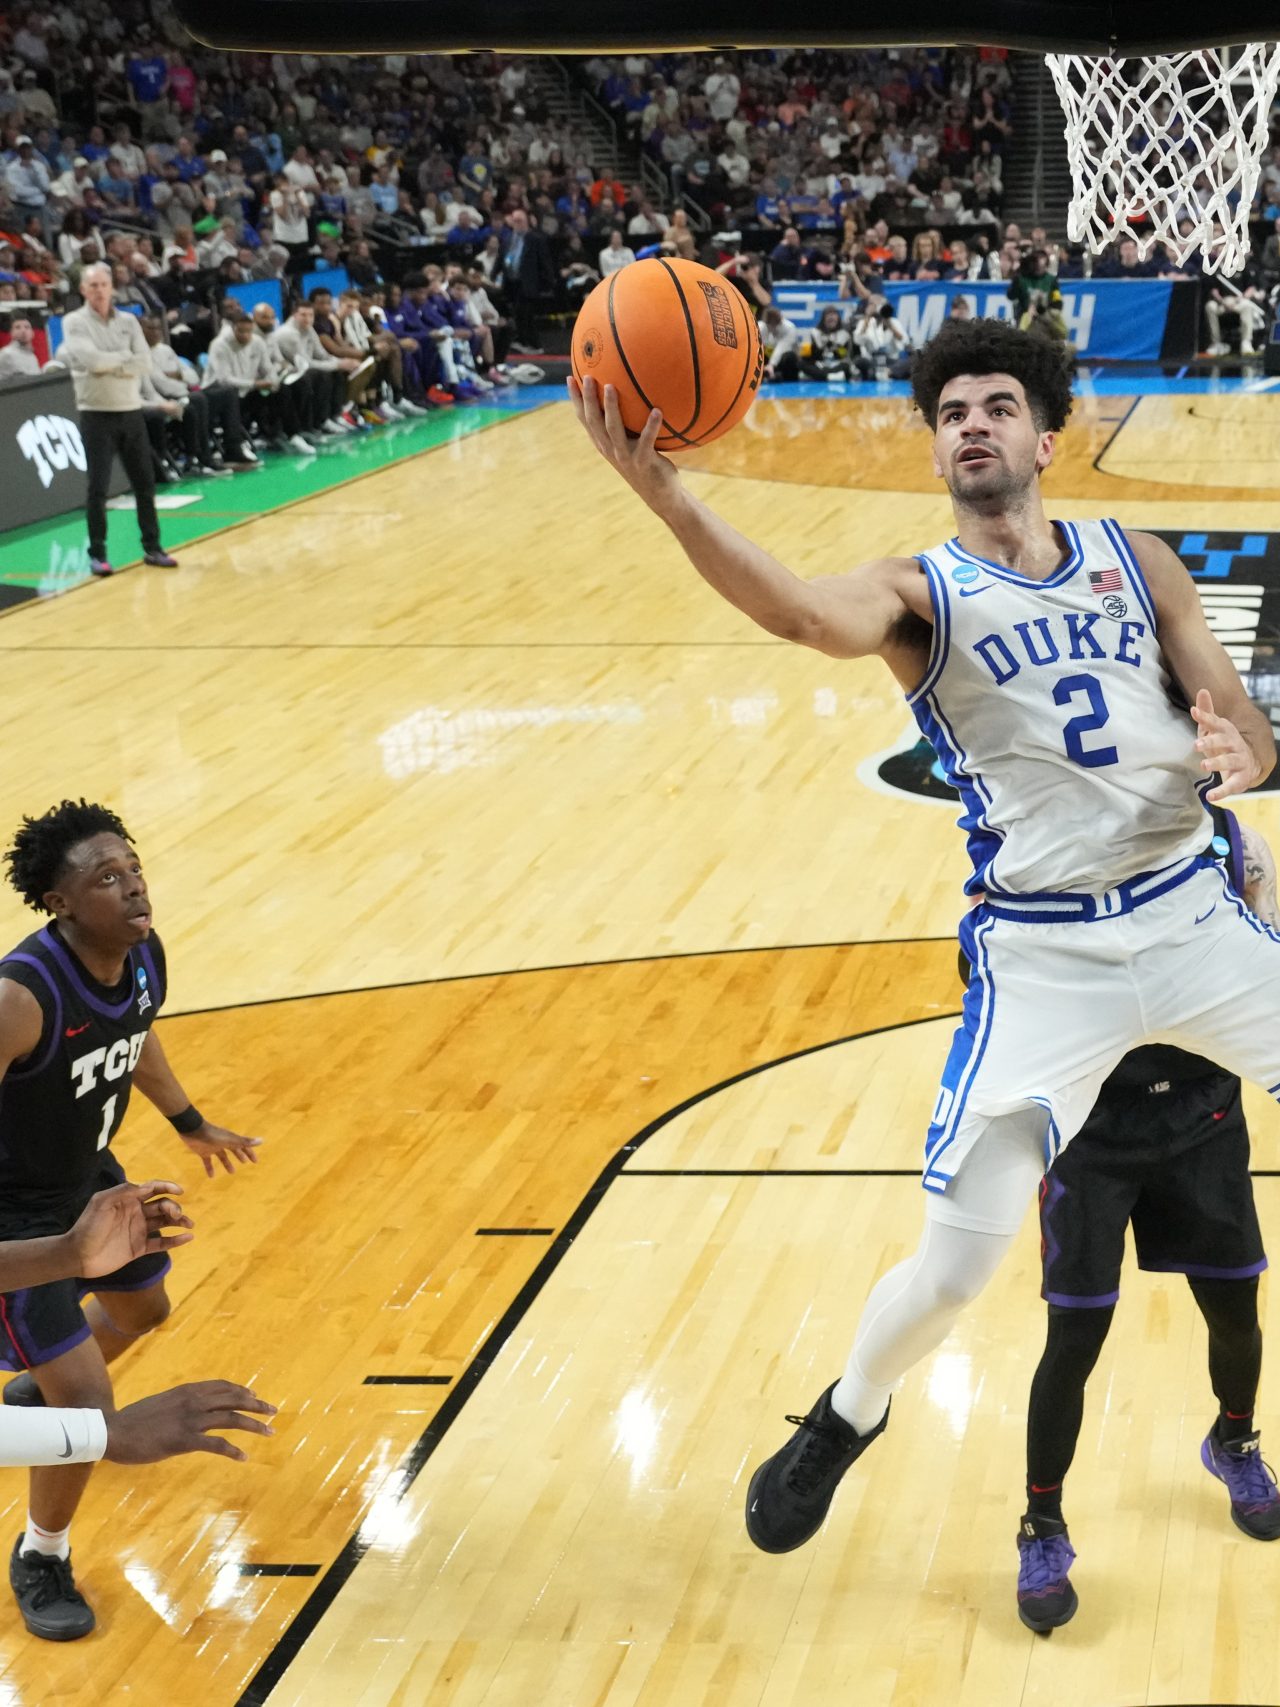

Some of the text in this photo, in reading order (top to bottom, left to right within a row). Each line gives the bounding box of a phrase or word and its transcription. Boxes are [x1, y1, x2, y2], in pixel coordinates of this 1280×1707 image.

[15, 413, 88, 489] TCU
[972, 613, 1145, 686] DUKE
[1052, 672, 1119, 768] 2
[71, 1030, 148, 1099] TCU
[96, 1092, 119, 1152] 1
